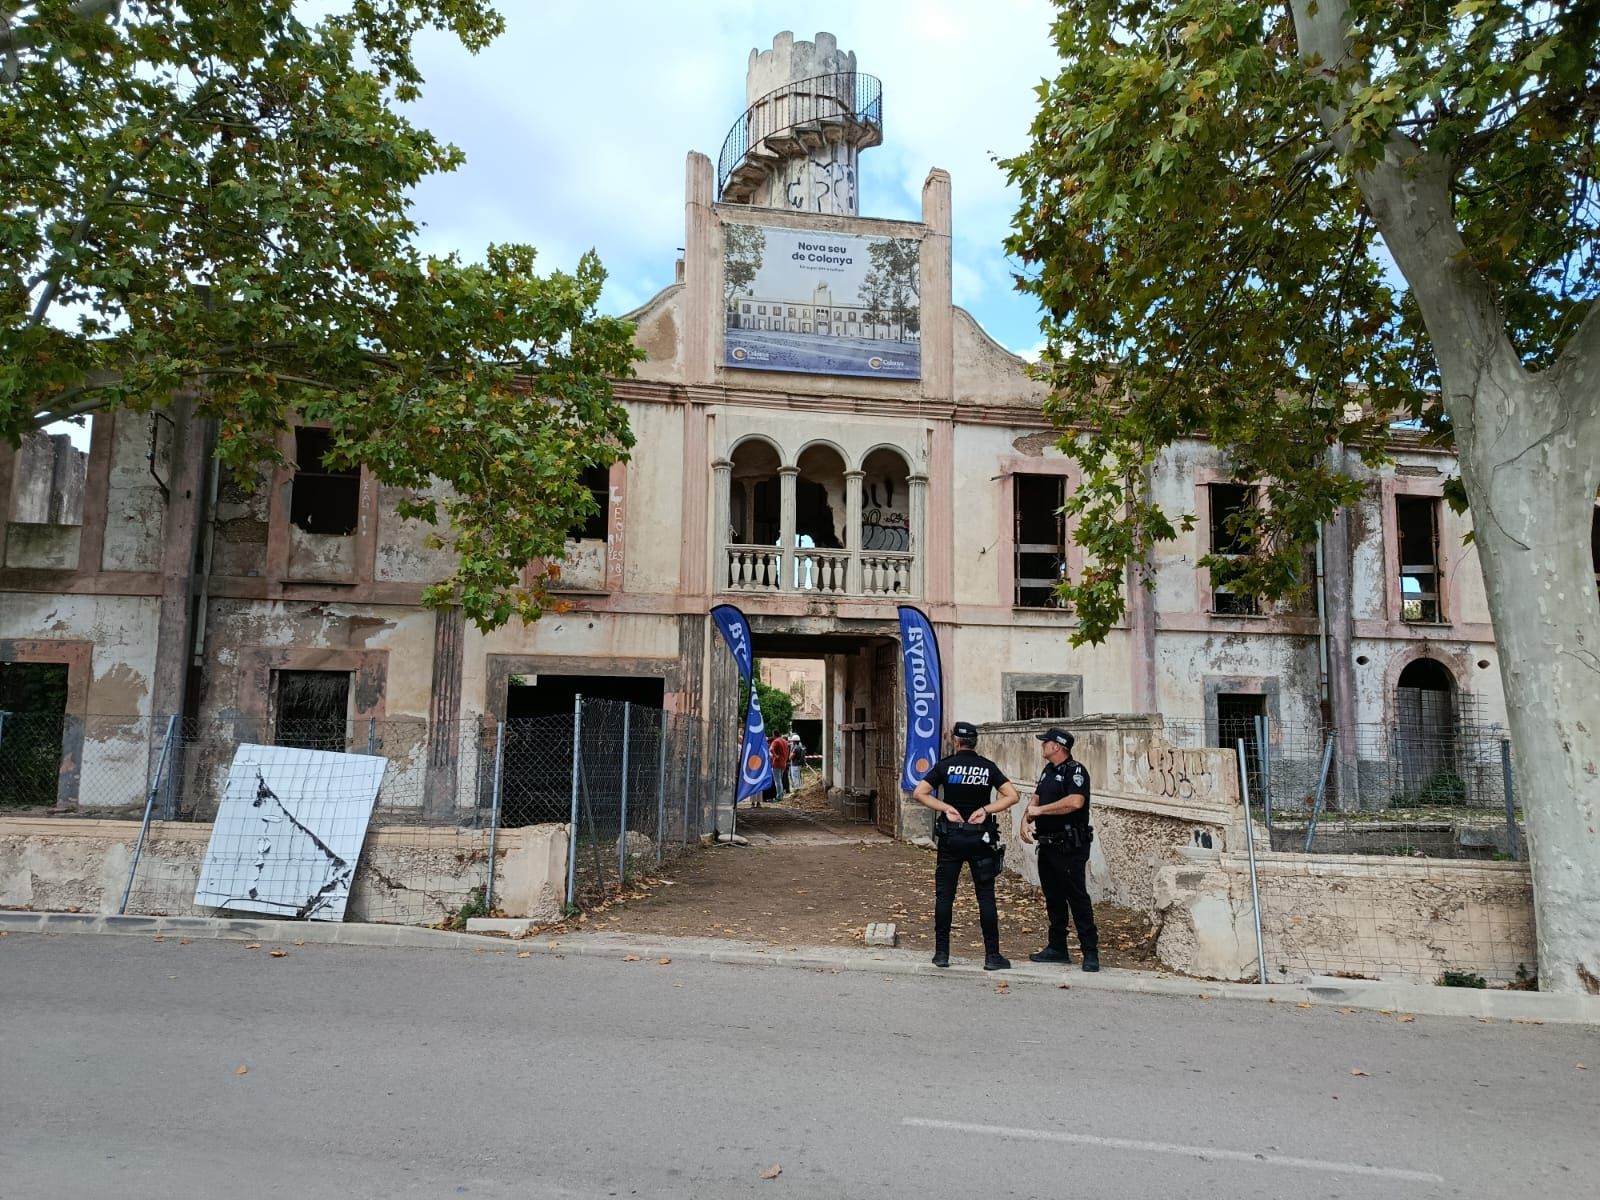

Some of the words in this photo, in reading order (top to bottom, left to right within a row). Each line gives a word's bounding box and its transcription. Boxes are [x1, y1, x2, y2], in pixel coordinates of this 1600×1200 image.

[798, 241, 826, 252] Nova
[828, 246, 846, 254] seu
[792, 252, 806, 261] de
[808, 253, 853, 266] Colonya
[947, 766, 989, 776] POLICIA
[961, 775, 989, 786] LOCAL
